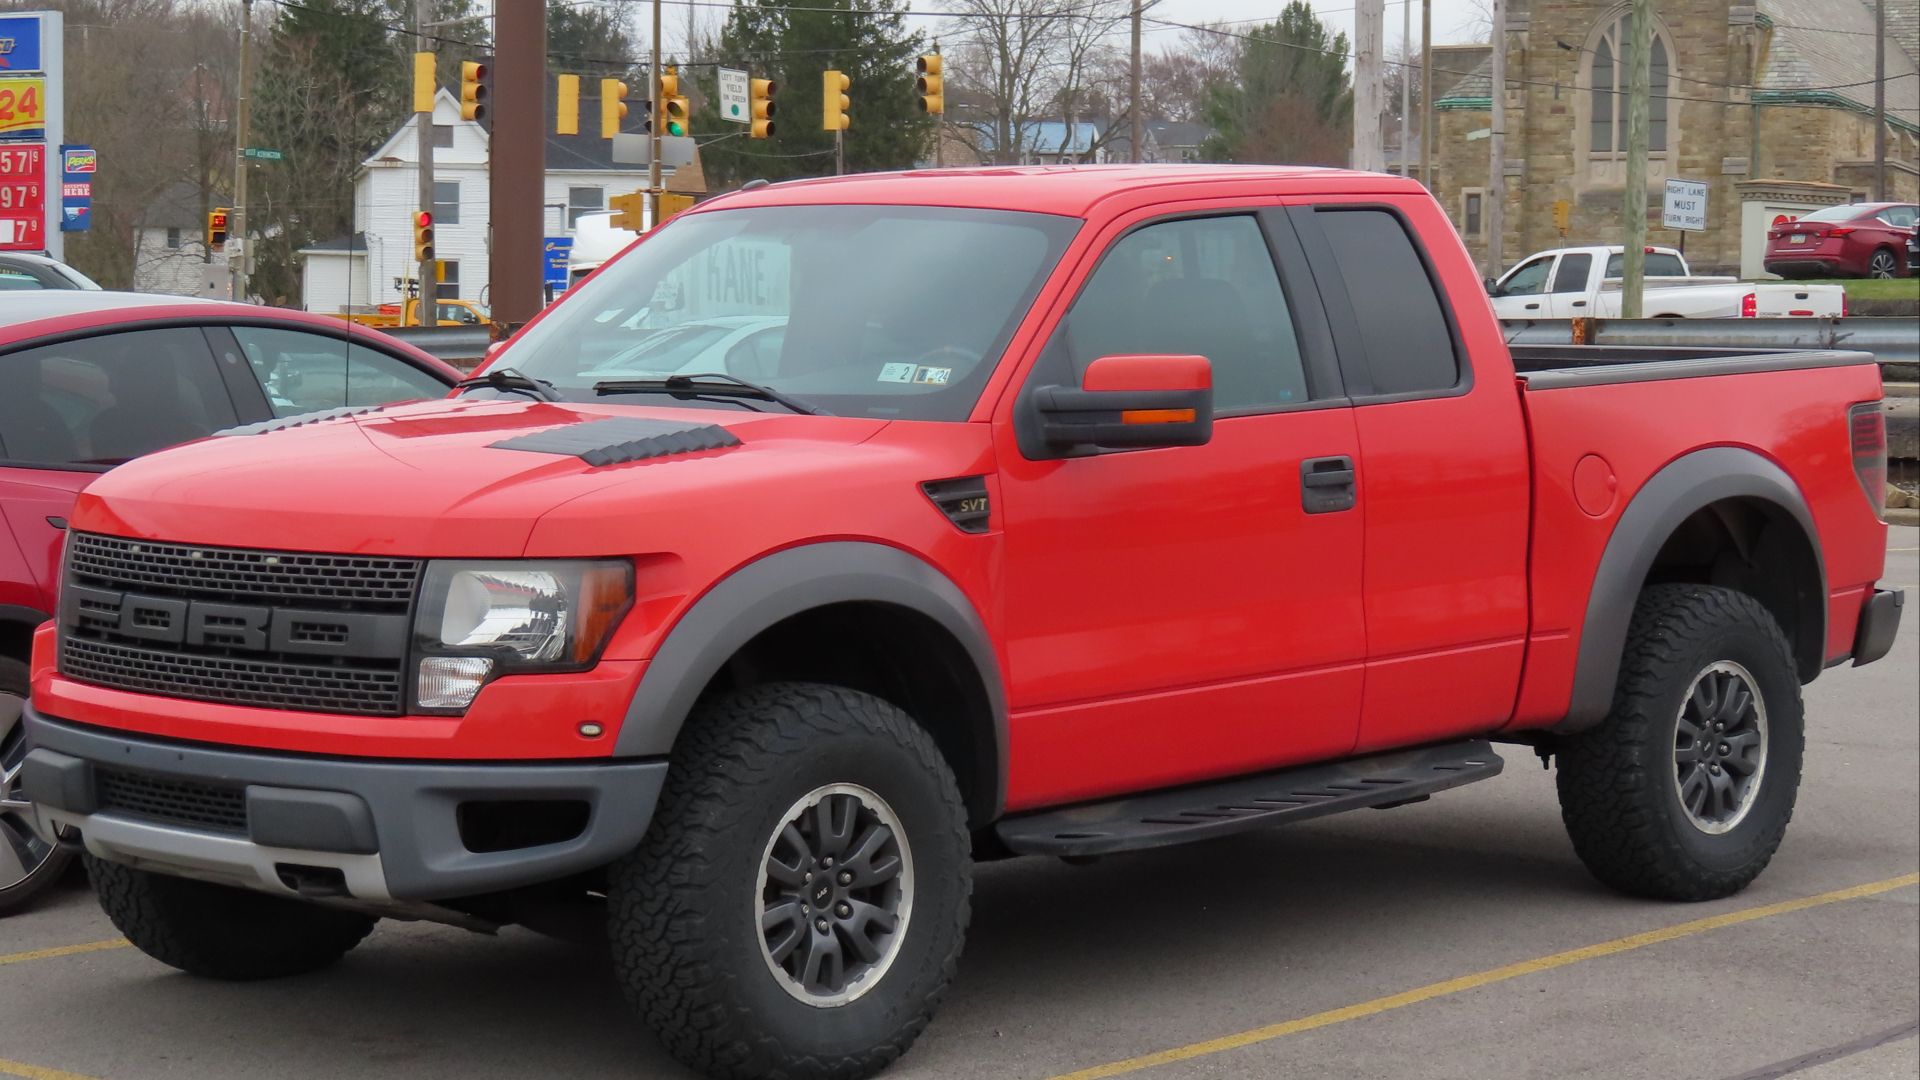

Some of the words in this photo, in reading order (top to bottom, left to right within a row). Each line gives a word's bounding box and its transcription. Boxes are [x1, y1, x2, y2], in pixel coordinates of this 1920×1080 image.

[726, 84, 742, 93] YIELD
[732, 95, 746, 103] GREEN
[64, 188, 91, 196] HERE
[1667, 186, 1685, 194] RIGHT
[1688, 188, 1705, 197] LANE
[1674, 200, 1696, 211] MUST
[1665, 214, 1681, 222] TURN
[1685, 216, 1704, 224] RIGHT
[961, 497, 987, 512] SVT
[64, 585, 400, 661] FORD
